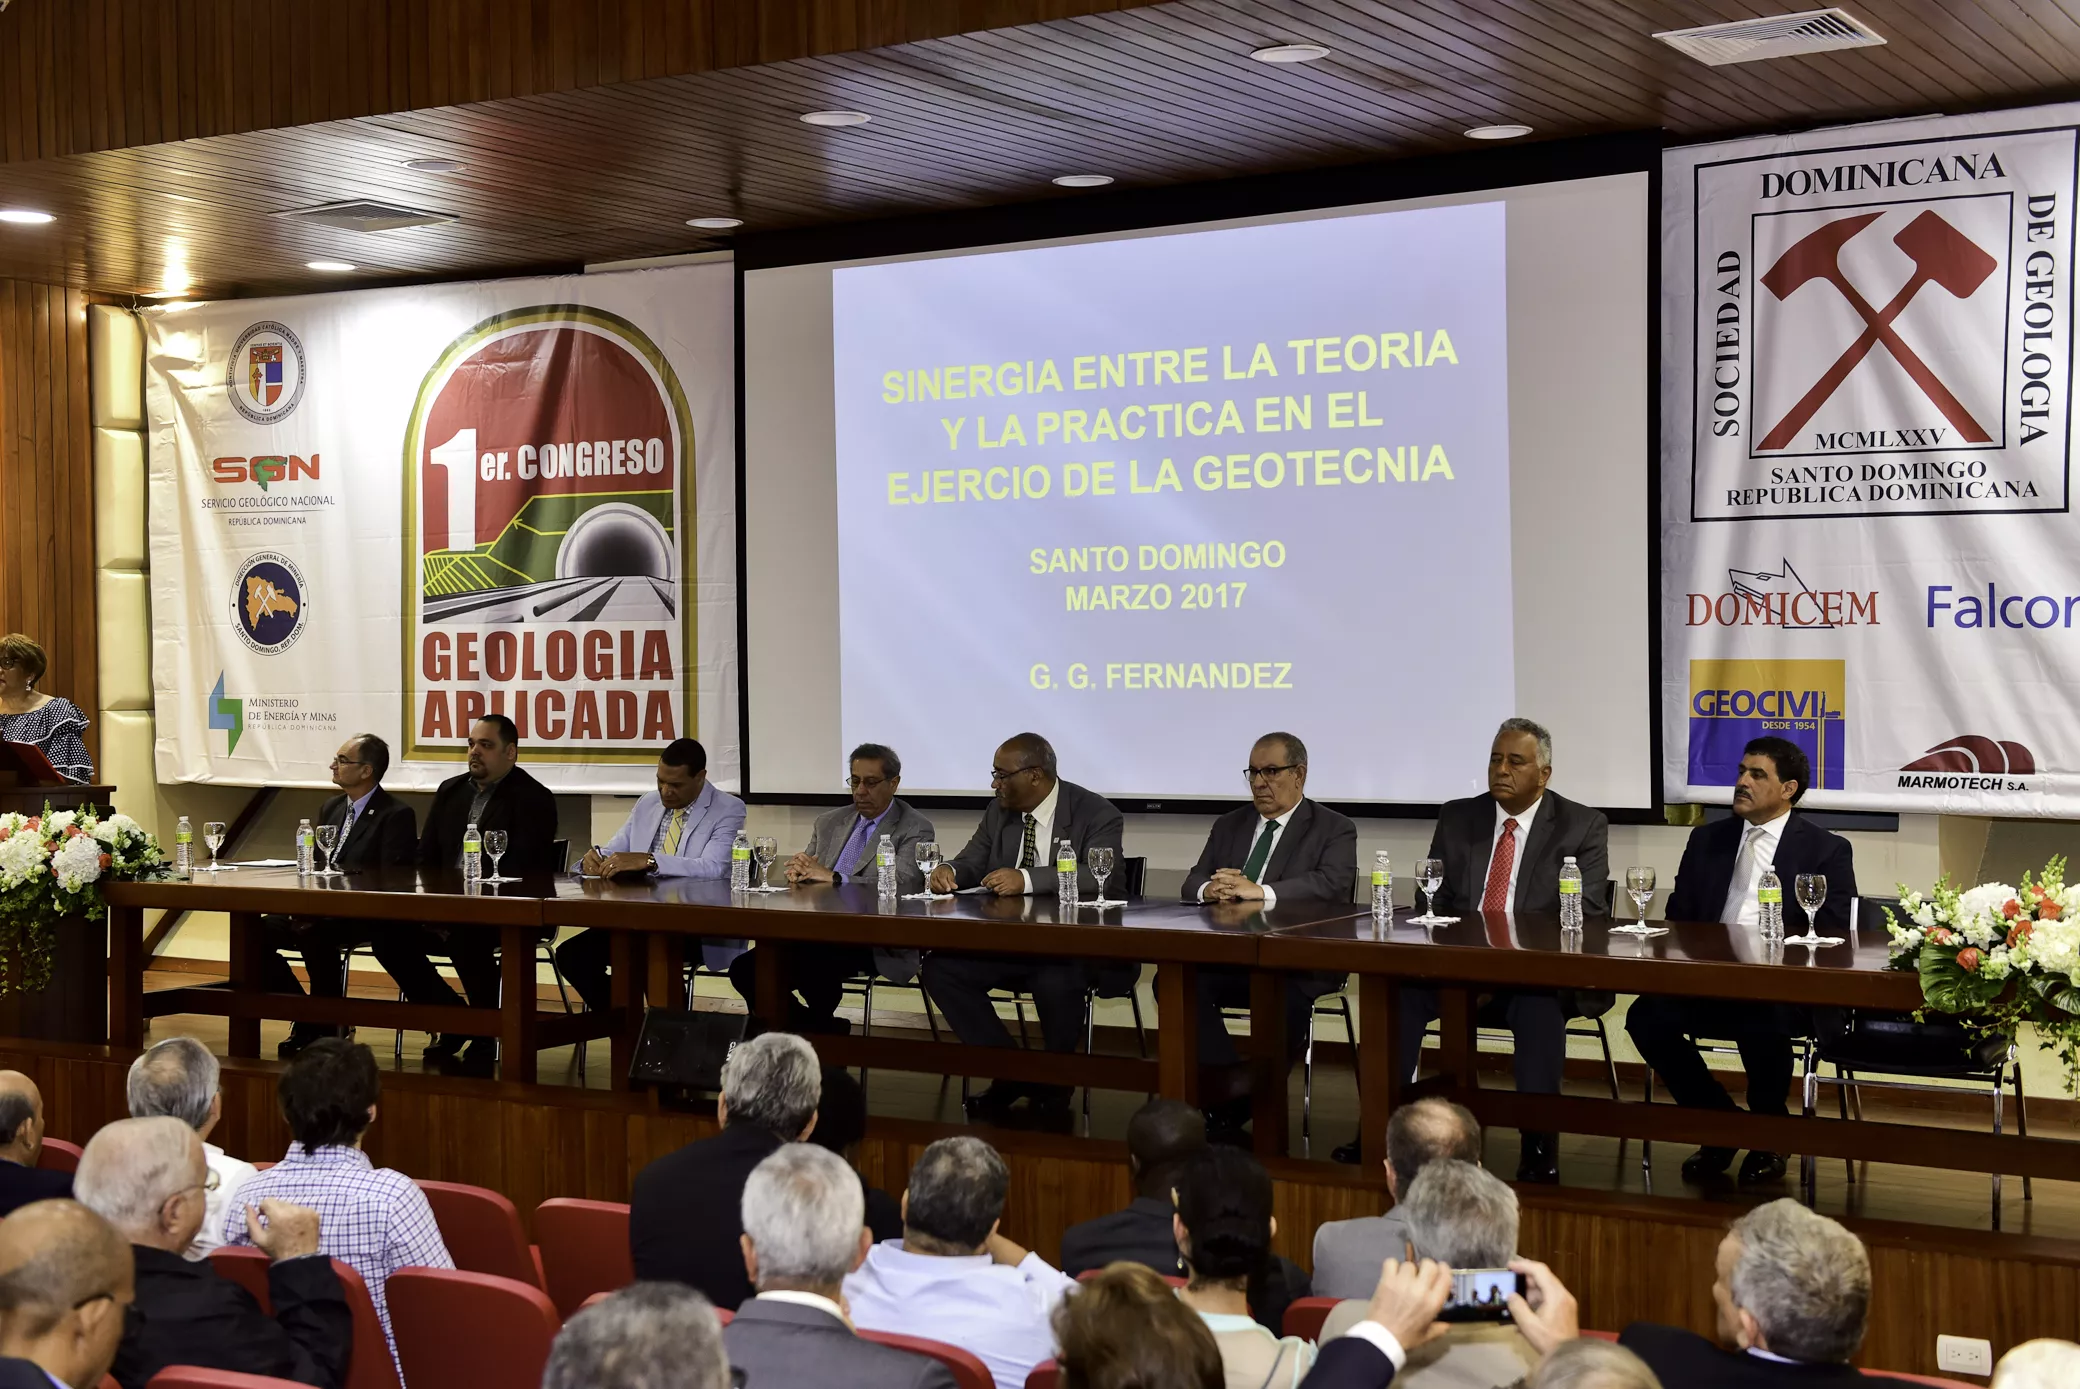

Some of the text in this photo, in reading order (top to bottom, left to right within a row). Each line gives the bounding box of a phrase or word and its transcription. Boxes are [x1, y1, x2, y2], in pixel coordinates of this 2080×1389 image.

[1760, 151, 2007, 200] DOMINICANA
[2020, 191, 2056, 447] DE GEOLOGIA
[286, 331, 300, 348] MADRE
[1712, 250, 1741, 437] SOCIEDAD
[882, 329, 1459, 404] SINERGIA ENTRE LA TEORIA
[941, 391, 1383, 450] Y LA PRACTICA EN EL
[1815, 428, 1946, 450] MCMLXXV
[213, 454, 320, 485] SGN
[887, 444, 1455, 504] EJERCIO DE LA GEOTECNIA
[1771, 460, 1987, 485] SANTO DOMINGO
[201, 494, 335, 509] SERVICIO GEOLÓGICO NACIONAL
[430, 428, 665, 551] 1 er. CONGRESO
[1726, 480, 2039, 507] REPUBLICA DOMINICANA
[228, 516, 307, 526] REPÚBLICA DOMINICANA
[255, 553, 280, 562] GENERAL
[287, 563, 304, 589] MINERÍA
[1029, 540, 1286, 574] SANTO DOMINGO
[1066, 582, 1248, 611] MARZO 2017
[1685, 590, 1880, 626] DOMICEM
[235, 621, 305, 654] SANTO DOMINGO, REP. DOM.
[423, 630, 674, 682] GEOLOGIA
[1029, 662, 1293, 690] G. G. FERNANDEZ
[248, 712, 262, 720] DE
[301, 713, 308, 721] Y
[1762, 721, 1816, 730] DESDE 1954
[1897, 775, 2030, 791] MARMOTECH S.A.
